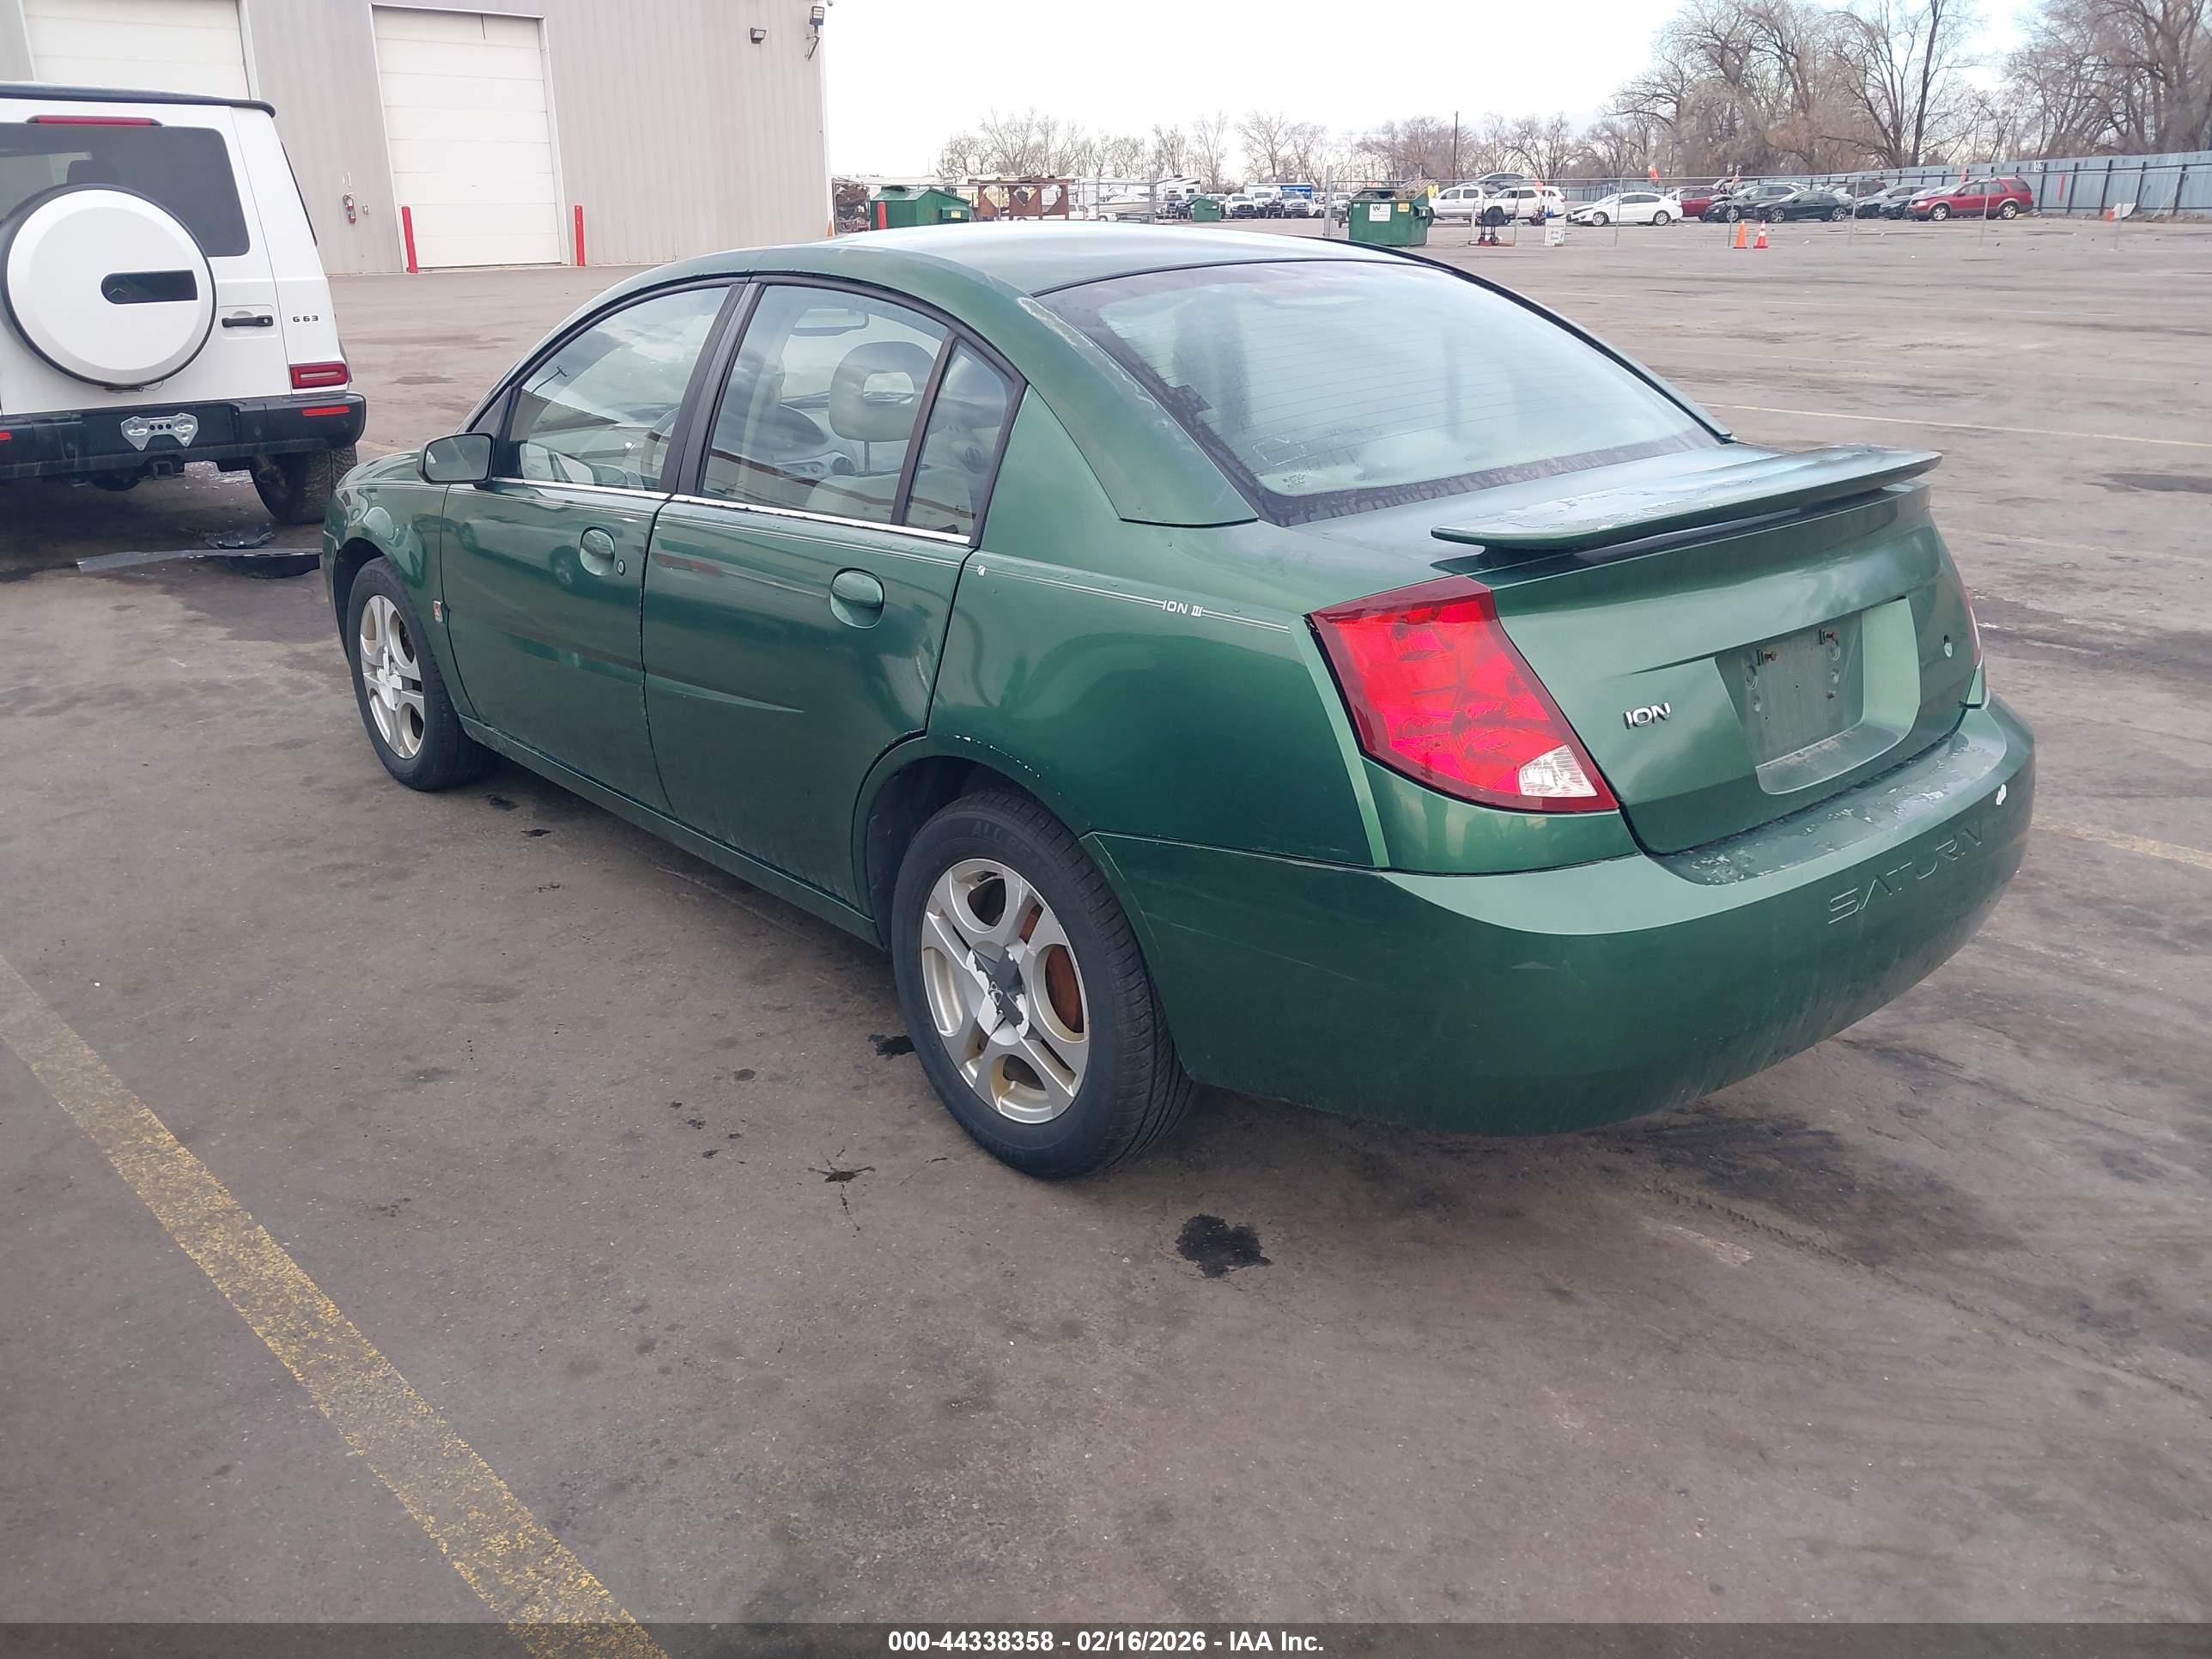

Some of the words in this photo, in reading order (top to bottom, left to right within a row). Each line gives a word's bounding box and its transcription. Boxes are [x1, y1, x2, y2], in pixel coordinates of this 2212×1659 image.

[1162, 599, 1188, 615] ION
[1623, 702, 1671, 730] ION
[1827, 820, 1983, 925] SATURN
